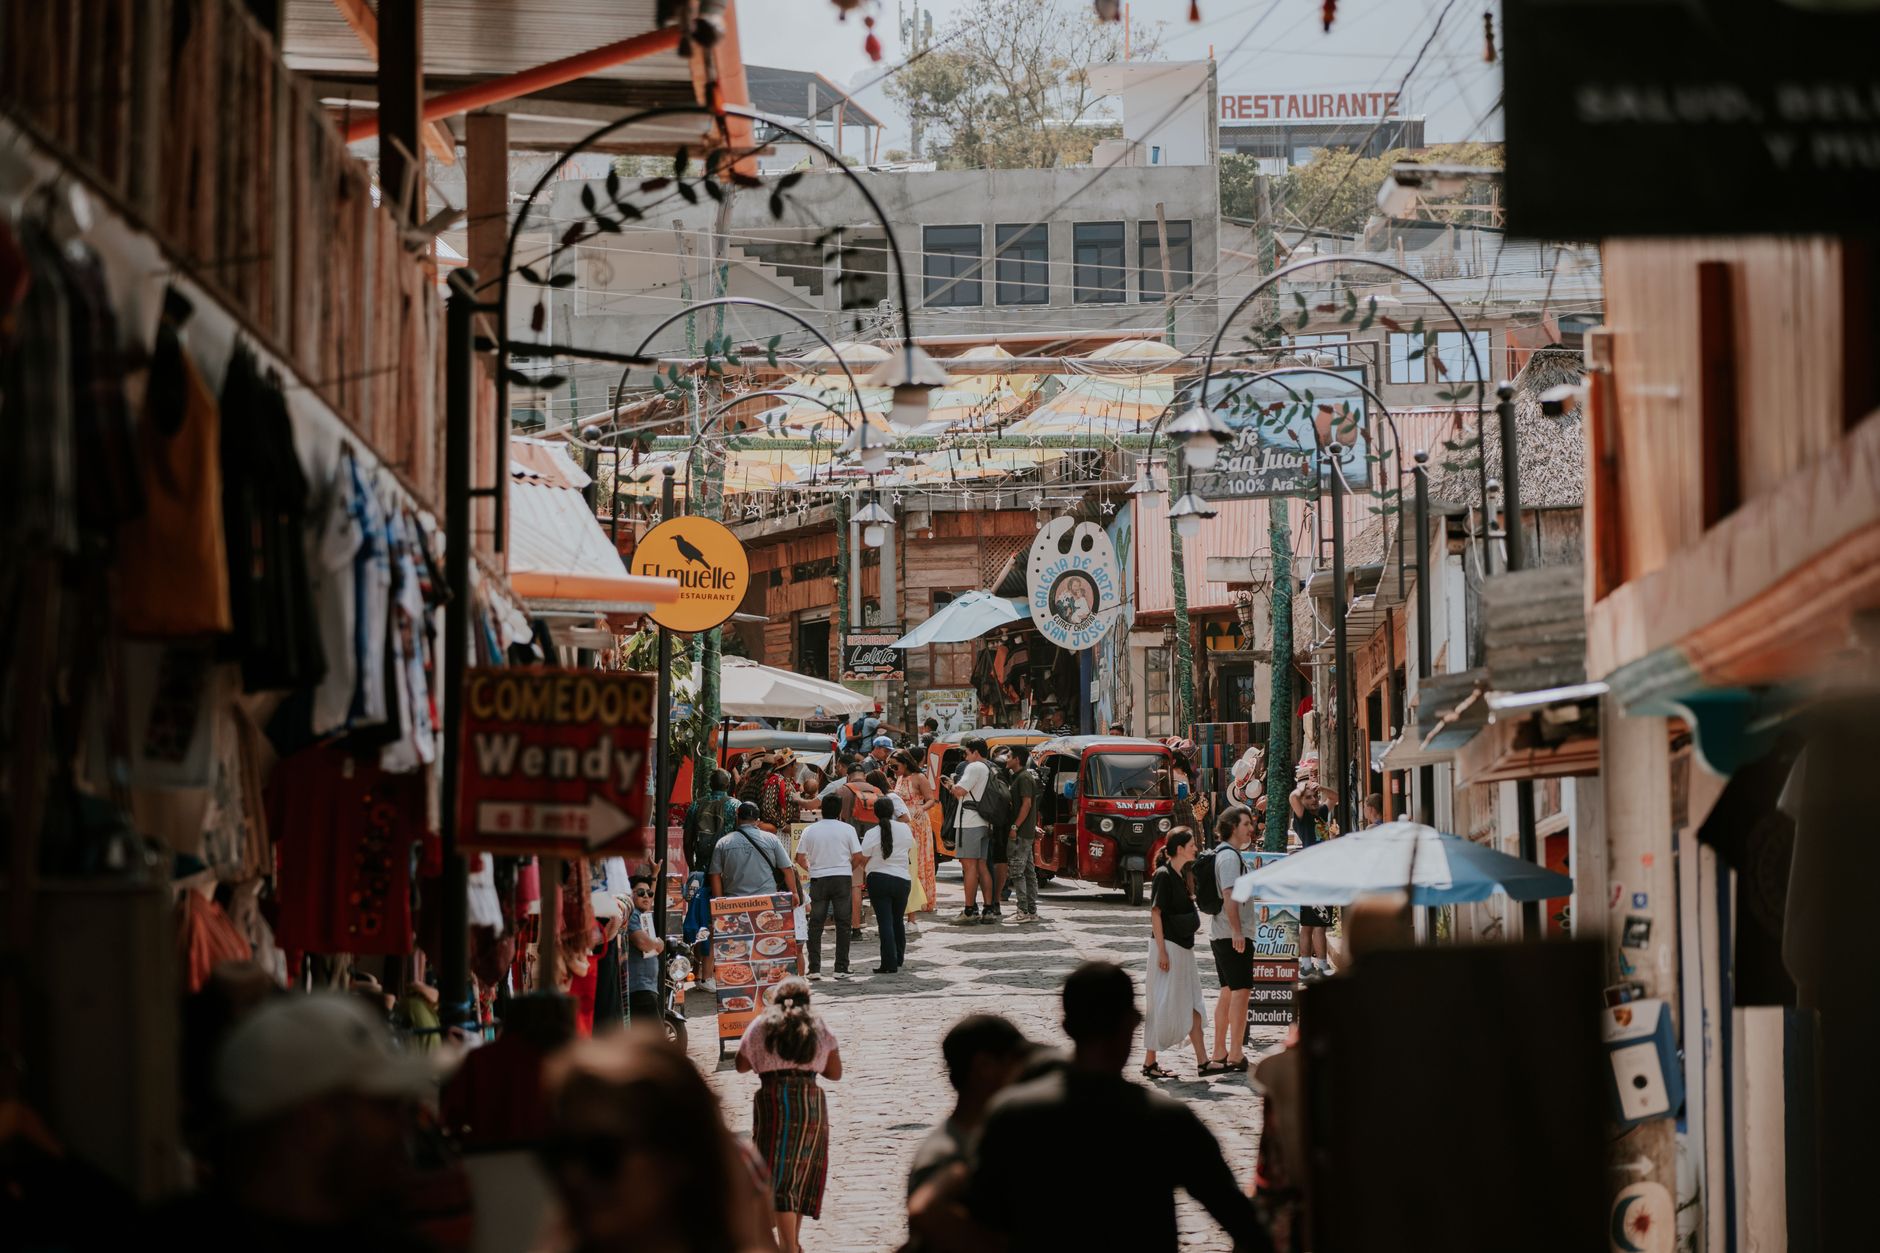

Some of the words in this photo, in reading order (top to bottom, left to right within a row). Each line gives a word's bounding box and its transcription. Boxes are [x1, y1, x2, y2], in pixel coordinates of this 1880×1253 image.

[1221, 93, 1400, 119] RESTAURANTE
[1228, 479, 1265, 494] 100%
[666, 566, 736, 589] muelle
[1035, 558, 1069, 608] GALERIA
[1072, 555, 1092, 570] DE
[1092, 567, 1114, 600] ARTE
[680, 592, 736, 601] ESTAURANTE
[1043, 621, 1068, 643] SAN
[1072, 620, 1105, 647] JOSE
[849, 646, 897, 666] Lolita
[471, 676, 650, 725] COMEDOR
[474, 732, 642, 794] Wendy
[1116, 801, 1133, 809] SAN
[1135, 801, 1156, 810] JUAN
[714, 899, 768, 911] Bienvenidos
[1257, 924, 1286, 941] Café
[1253, 965, 1274, 978] offee
[1275, 965, 1296, 978] Tour
[1247, 1009, 1293, 1022] Chocolate
